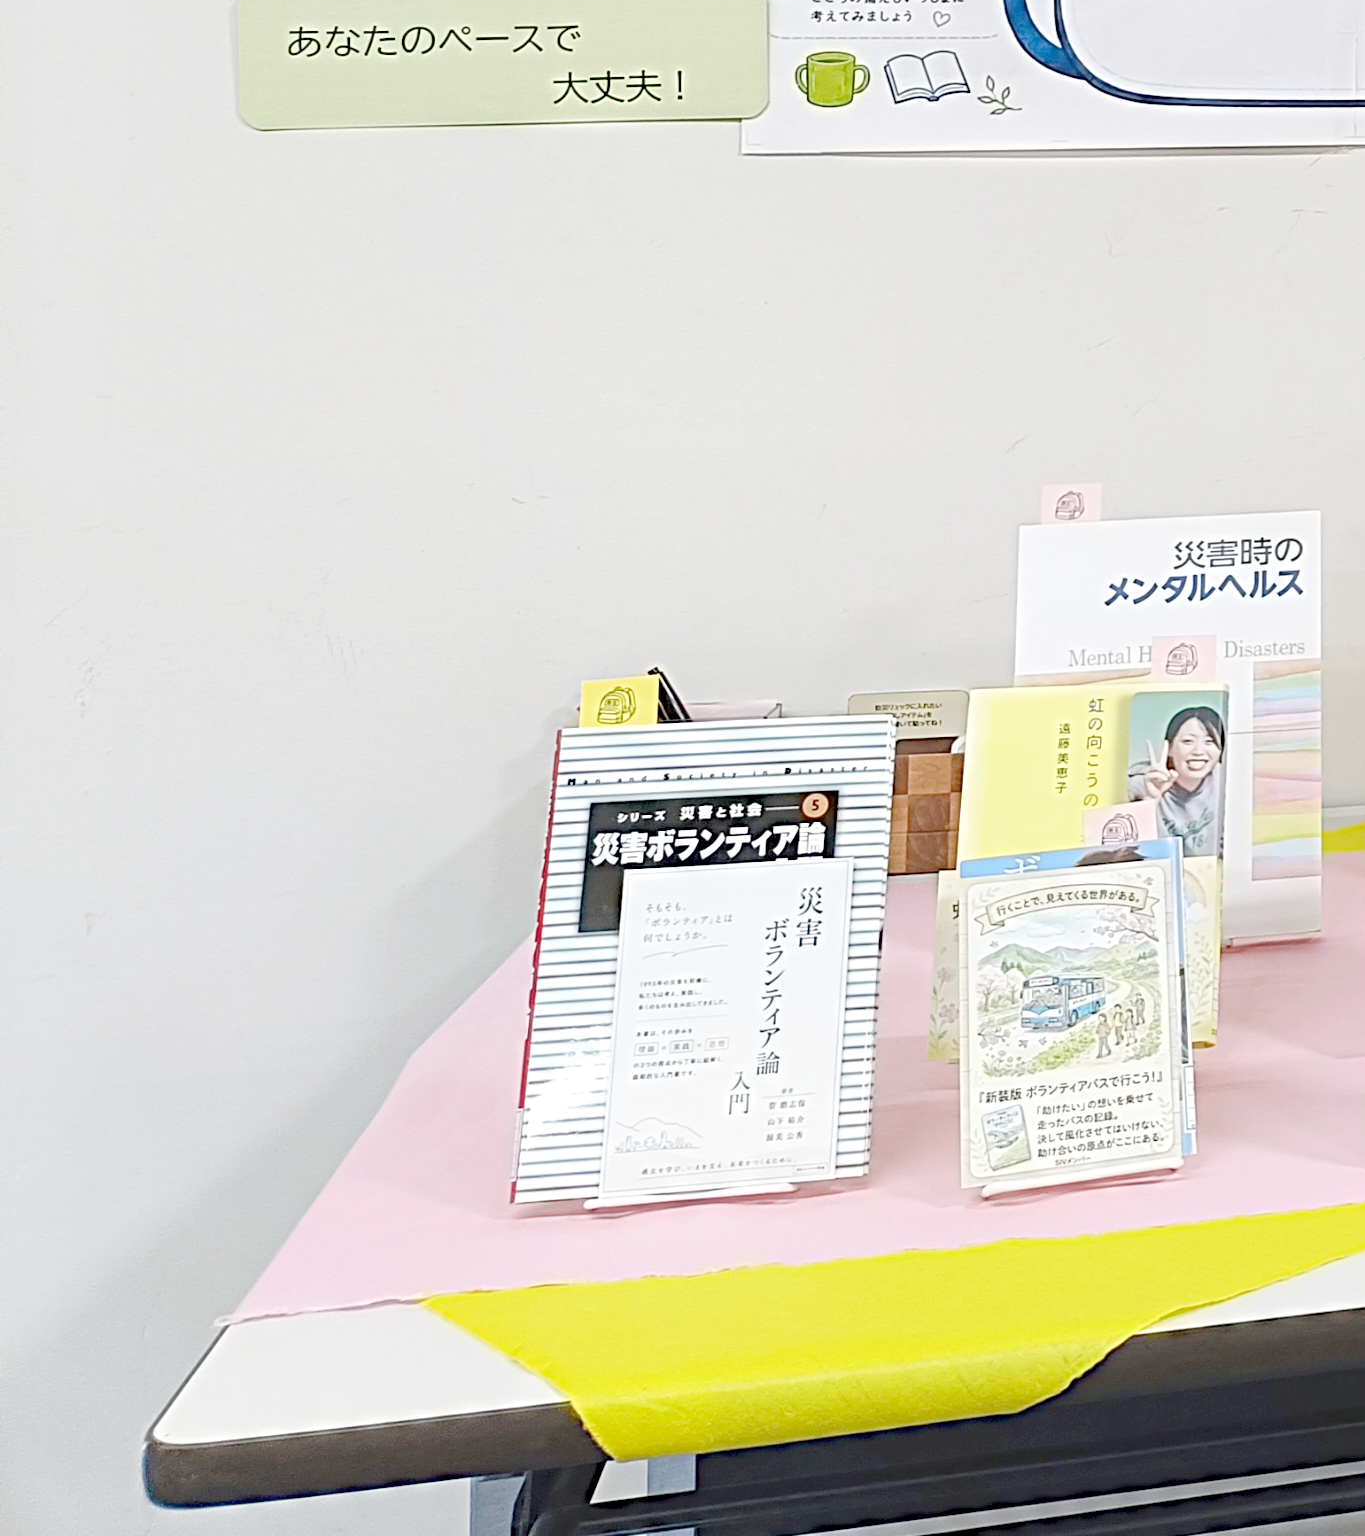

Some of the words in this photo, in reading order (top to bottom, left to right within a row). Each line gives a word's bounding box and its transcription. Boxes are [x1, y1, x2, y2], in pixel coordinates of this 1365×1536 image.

[810, 9, 913, 25] 考えてみましょう
[287, 22, 581, 58] あなたのペースで
[1173, 537, 1303, 570] 災害時の
[1104, 570, 1304, 606] メンタルヘルス
[1068, 647, 1131, 667] Mental
[1224, 640, 1306, 658] Disasters
[1083, 698, 1105, 807] 虹の向こうの
[617, 810, 665, 823] シリーズ
[679, 803, 762, 818] 災害と社会
[811, 799, 820, 811] 5
[592, 821, 825, 866] 災害ボランティア論
[646, 903, 687, 913] そもそも、
[996, 889, 1142, 917] 行くことで、見えてくる世界がある。
[796, 886, 823, 948] 災害
[643, 931, 709, 943] 何でしょうか。
[756, 918, 789, 1076] ボランティア論
[728, 1071, 750, 1115] 入門
[977, 1089, 1022, 1104] 『新装版
[1037, 1092, 1154, 1116] 「助けたい」の想いを乗せて
[1037, 1113, 1118, 1131] 走ったバスの記録。
[1038, 1133, 1165, 1158] 助け合いの原点がここにある。
